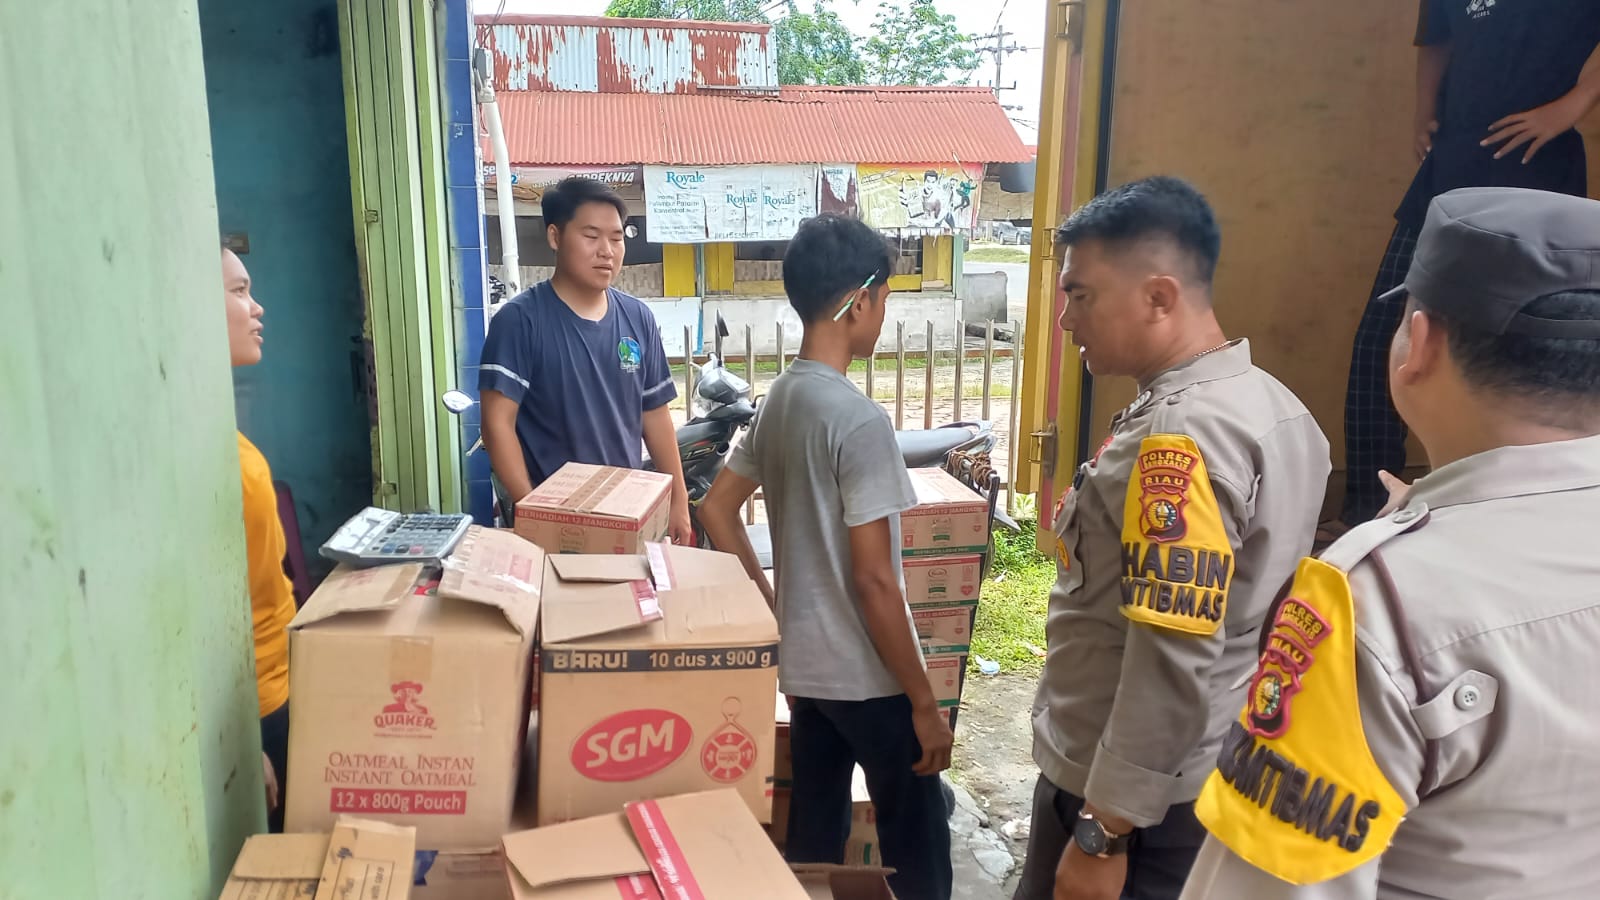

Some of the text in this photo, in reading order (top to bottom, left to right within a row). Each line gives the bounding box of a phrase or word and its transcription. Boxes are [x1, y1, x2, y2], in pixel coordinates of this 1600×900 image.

[666, 171, 705, 189] Royale
[726, 192, 757, 208] Royale
[763, 194, 795, 209] Royale
[1143, 452, 1192, 465] POLRES
[1145, 476, 1184, 486] RIAU
[518, 510, 569, 523] BERHADIAH
[582, 517, 627, 529] MANGKOK
[1122, 542, 1231, 589] HABIN
[553, 650, 771, 668] BARU! 10 dus x 900 g
[374, 714, 437, 730] QUAKER
[586, 719, 676, 768] SGM
[329, 752, 475, 770] OATMEAL INSTAN
[324, 767, 477, 786] INSTANT OATMEAL
[336, 792, 461, 812] 12 x 800g Pouch
